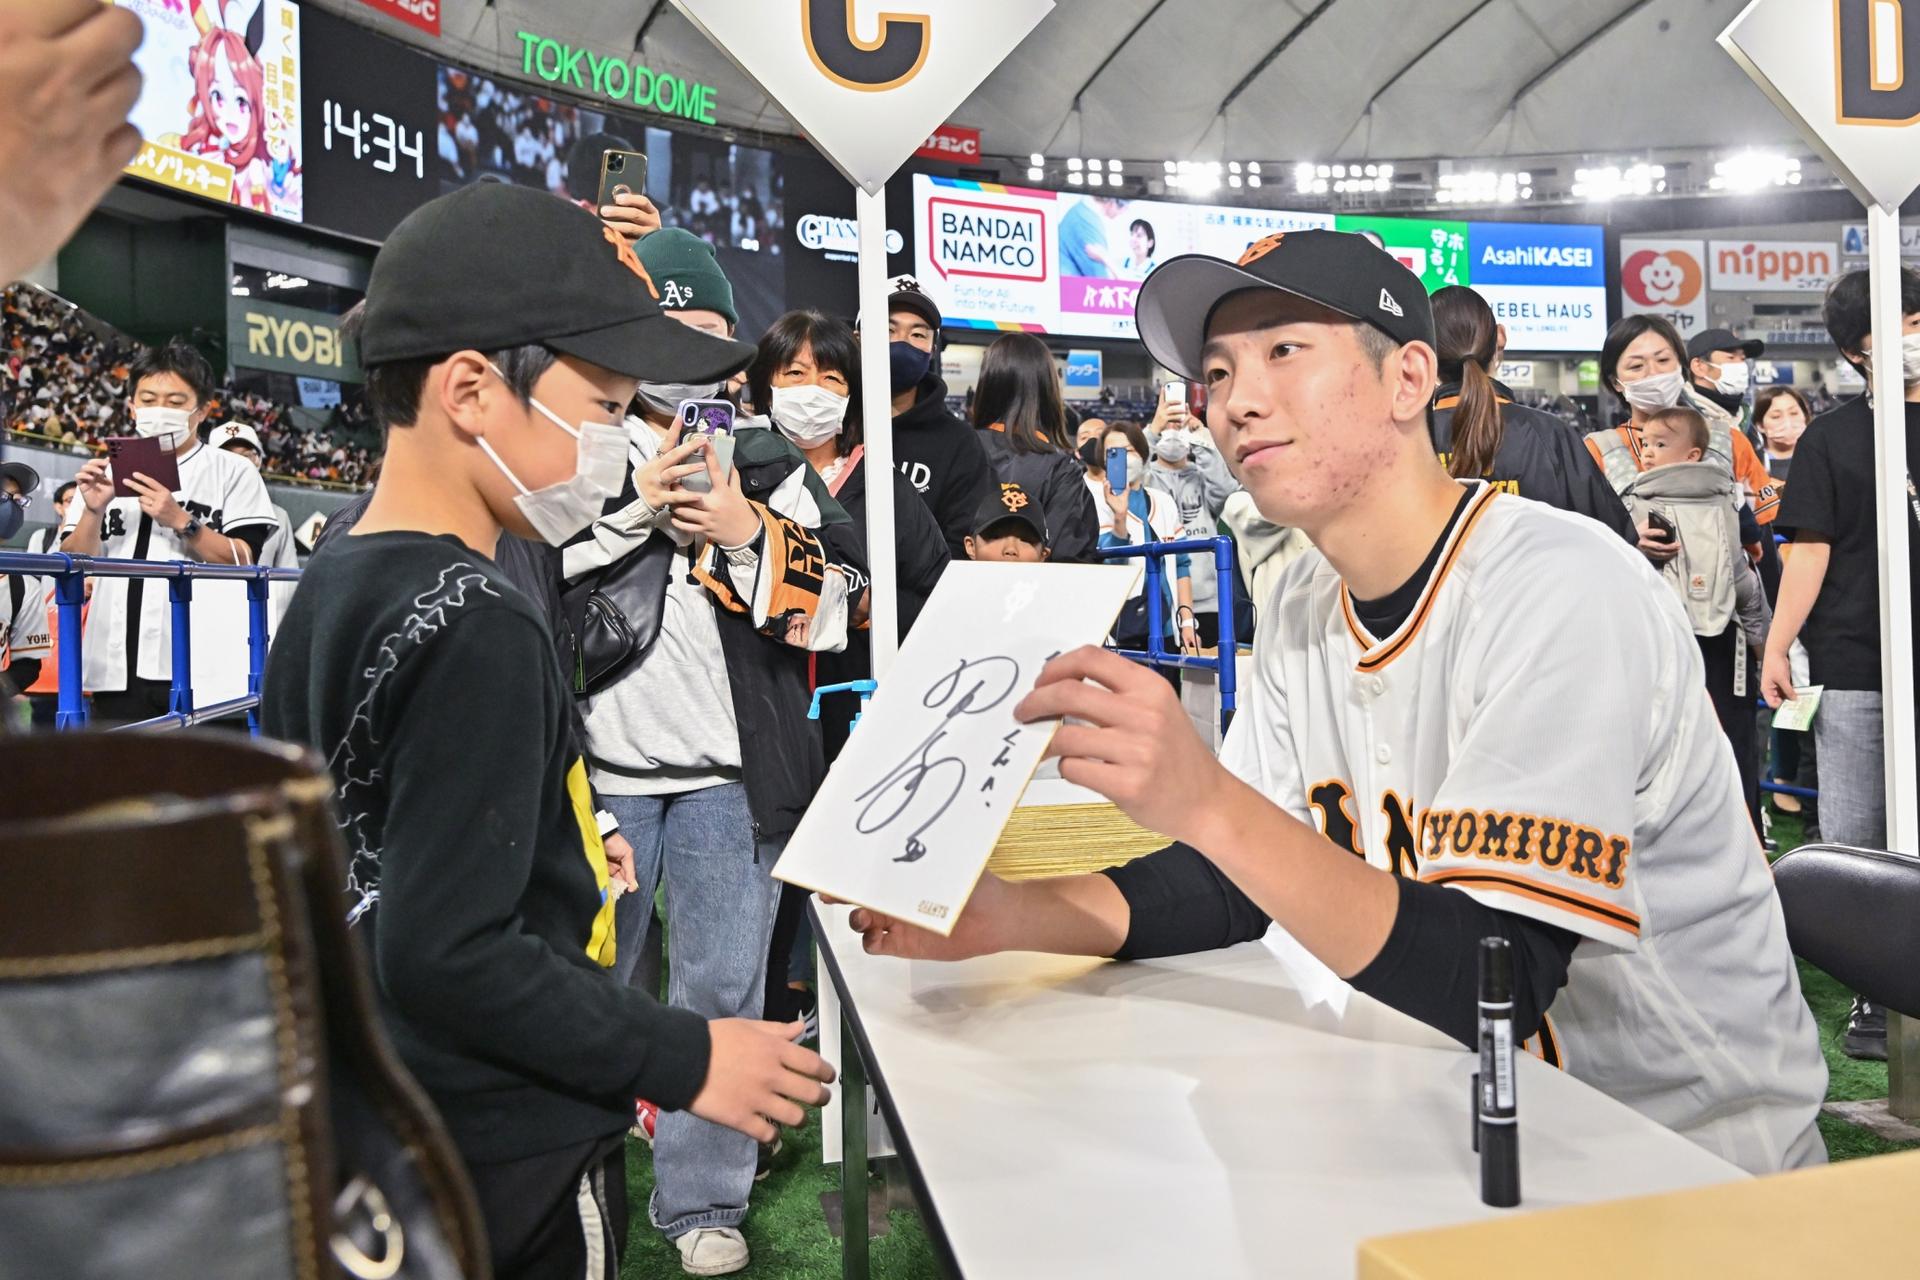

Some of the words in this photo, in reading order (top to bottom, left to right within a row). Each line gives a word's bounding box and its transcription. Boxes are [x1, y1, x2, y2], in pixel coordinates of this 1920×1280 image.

[517, 31, 630, 99] TOKYO
[634, 65, 717, 125] DOME
[323, 99, 423, 179] 14:34
[942, 212, 1033, 243] BANDAI
[943, 239, 1035, 267] NAMCO
[1481, 245, 1593, 267] AsahiKASEI
[1717, 243, 1830, 282] nippn
[658, 279, 694, 307] A's
[954, 284, 975, 296] Fun
[977, 287, 993, 297] for
[978, 301, 997, 311] the
[1000, 301, 1035, 314] Future
[1547, 303, 1593, 319] HAUS
[245, 312, 343, 368] RYOBI
[1427, 808, 1631, 891] YOMIURI
